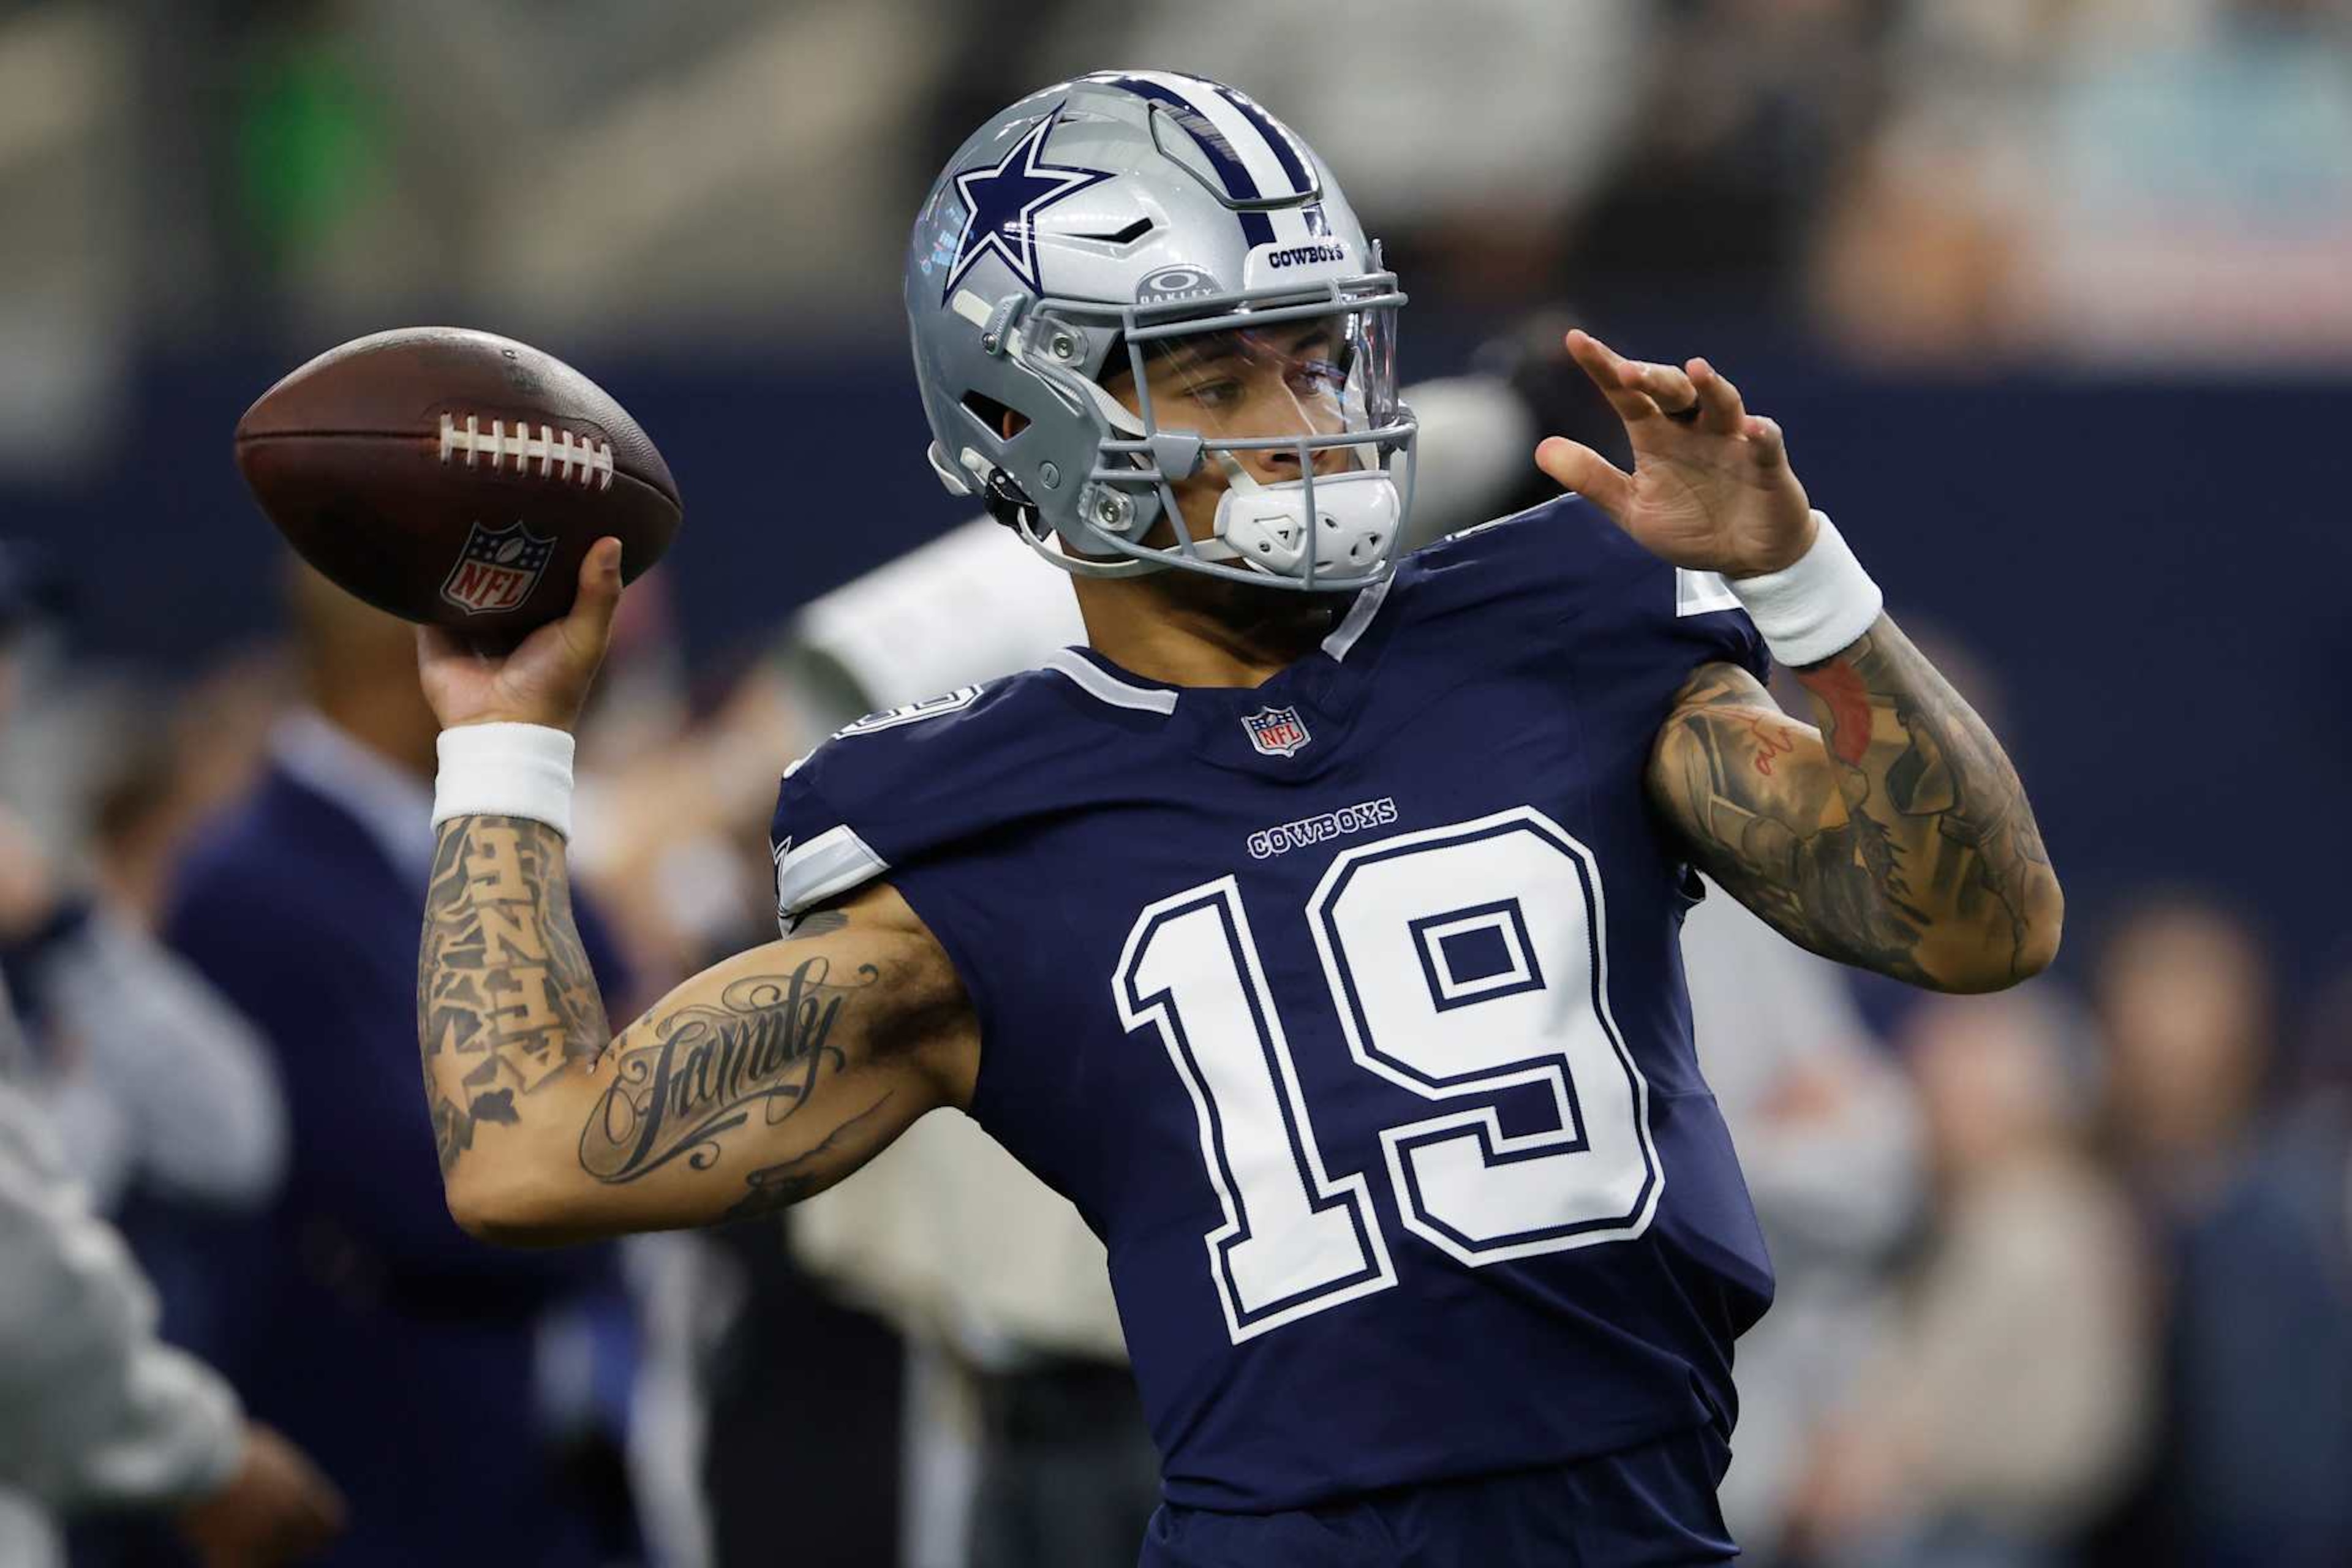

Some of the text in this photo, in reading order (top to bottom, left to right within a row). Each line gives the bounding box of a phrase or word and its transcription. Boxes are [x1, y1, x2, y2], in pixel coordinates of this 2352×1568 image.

[1268, 244, 1344, 268] COWBOYS
[451, 562, 527, 607] NFL
[1260, 724, 1300, 745] NFL
[1247, 797, 1398, 859] COWBOYS
[579, 956, 880, 1184] Family
[1111, 804, 1665, 1346] 19
